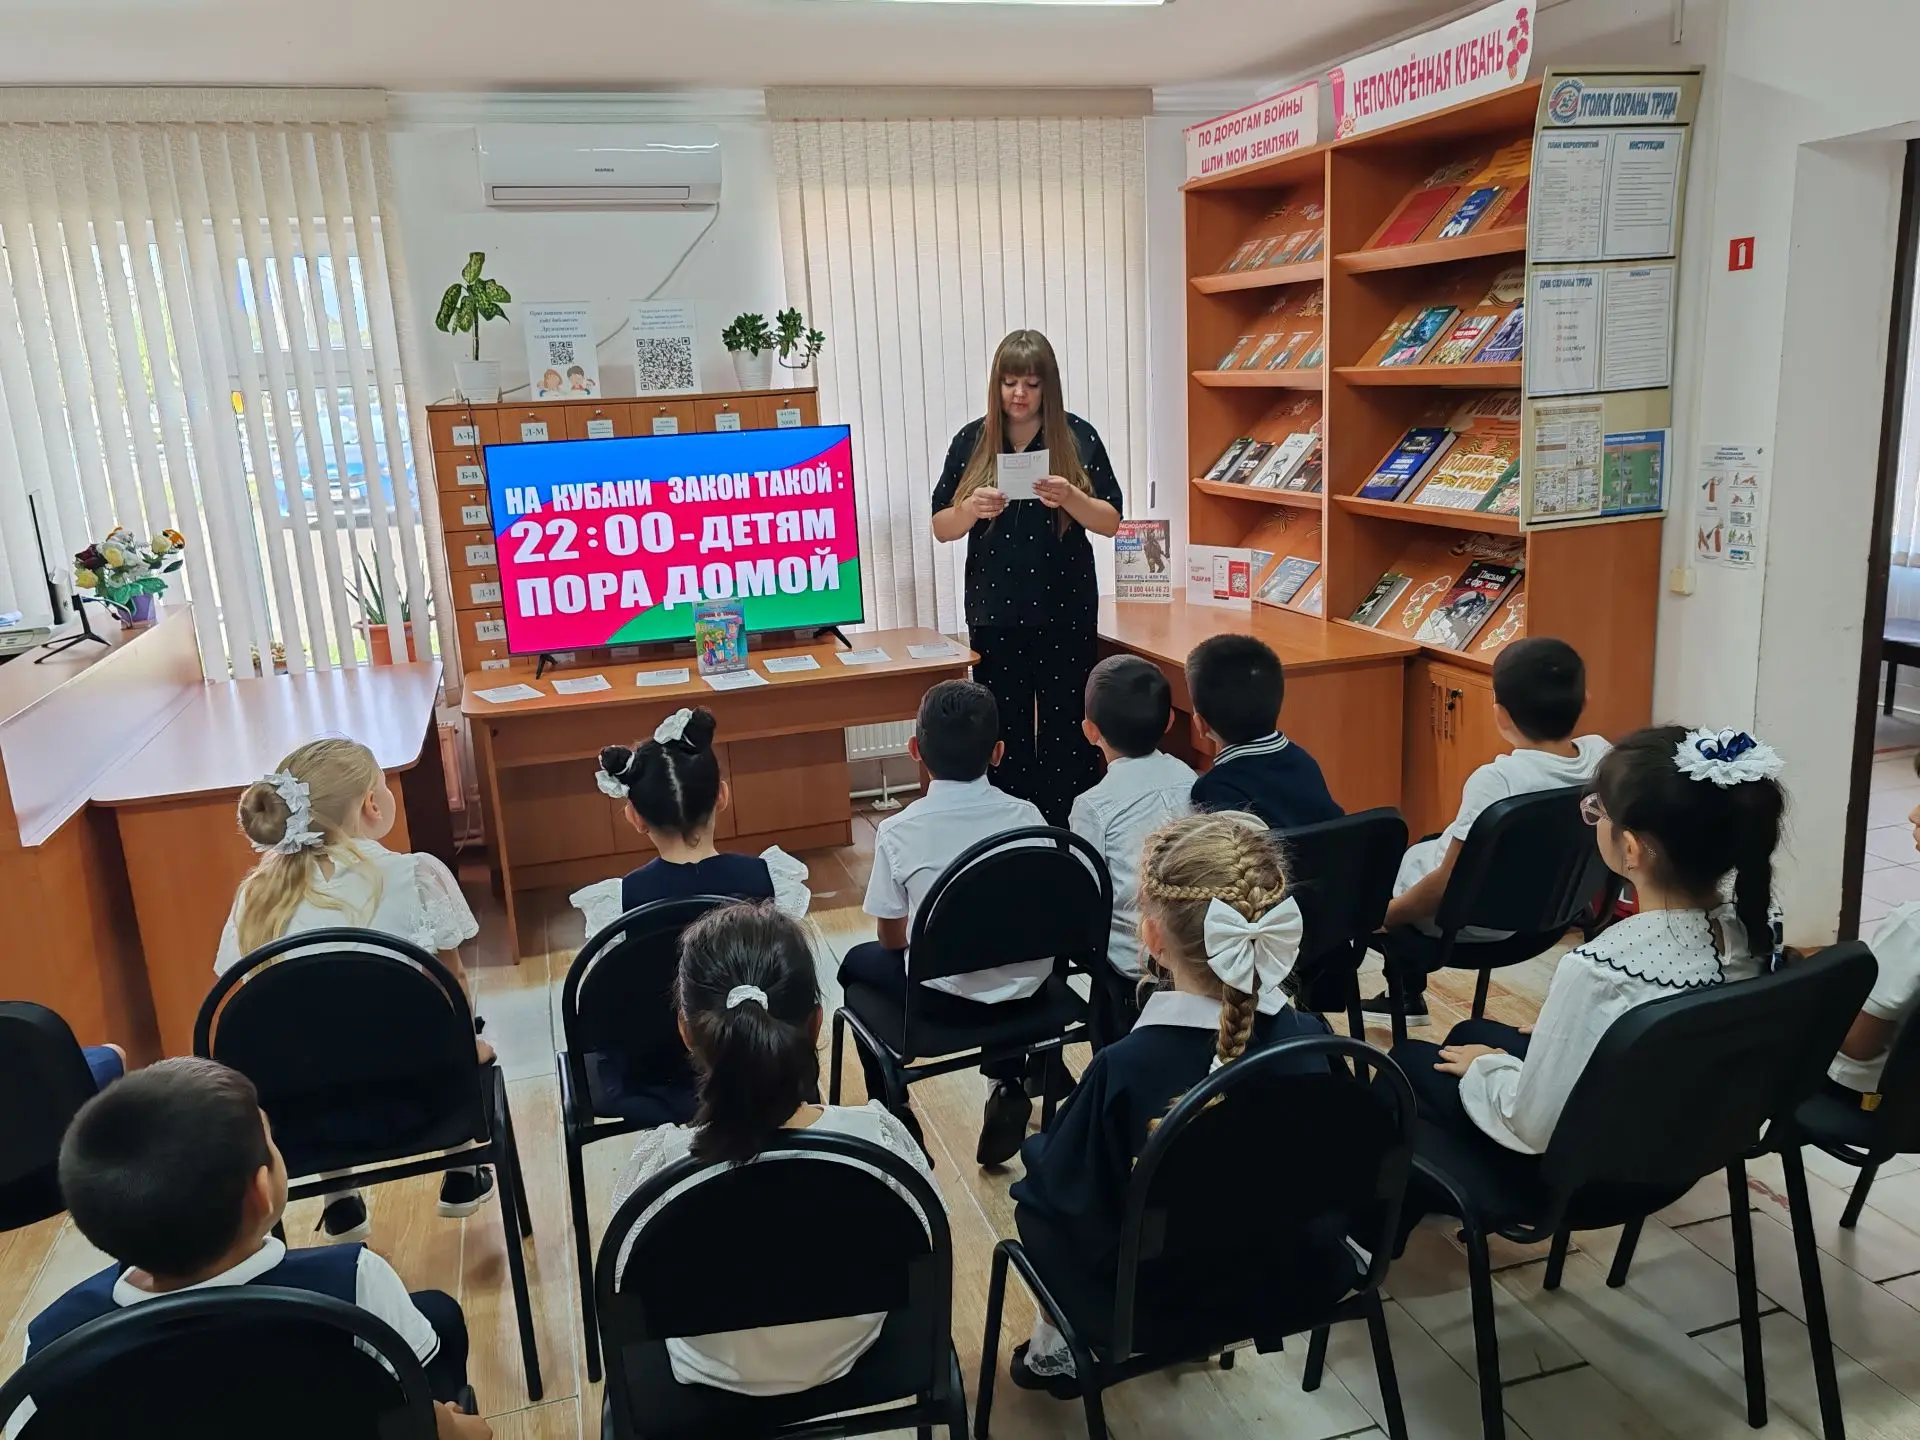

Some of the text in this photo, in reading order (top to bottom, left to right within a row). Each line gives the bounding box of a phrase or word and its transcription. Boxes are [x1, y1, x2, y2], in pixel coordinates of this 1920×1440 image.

[1353, 29, 1504, 117] НЕПОКОРЁННАЯ КУБАНЬ
[1198, 96, 1303, 148] ПО ДОРОГАМ ВОЙНЫ
[1578, 92, 1678, 119] УГОЛОК ОХРАНЫ ТРУДА
[1201, 129, 1299, 174] ШЛИ МОИ ЗЕМЛЯКИ
[1575, 277, 1593, 288] ТРУДА
[461, 471, 479, 480] Б-В
[505, 486, 543, 515] НА
[551, 478, 652, 511] КУБАНИ
[668, 471, 750, 504] ЗАКОН
[1117, 522, 1160, 530] РАСНОДАРСКИЙ
[516, 546, 840, 618] ПОРА ДОМОЙ
[1477, 569, 1506, 583] Письма
